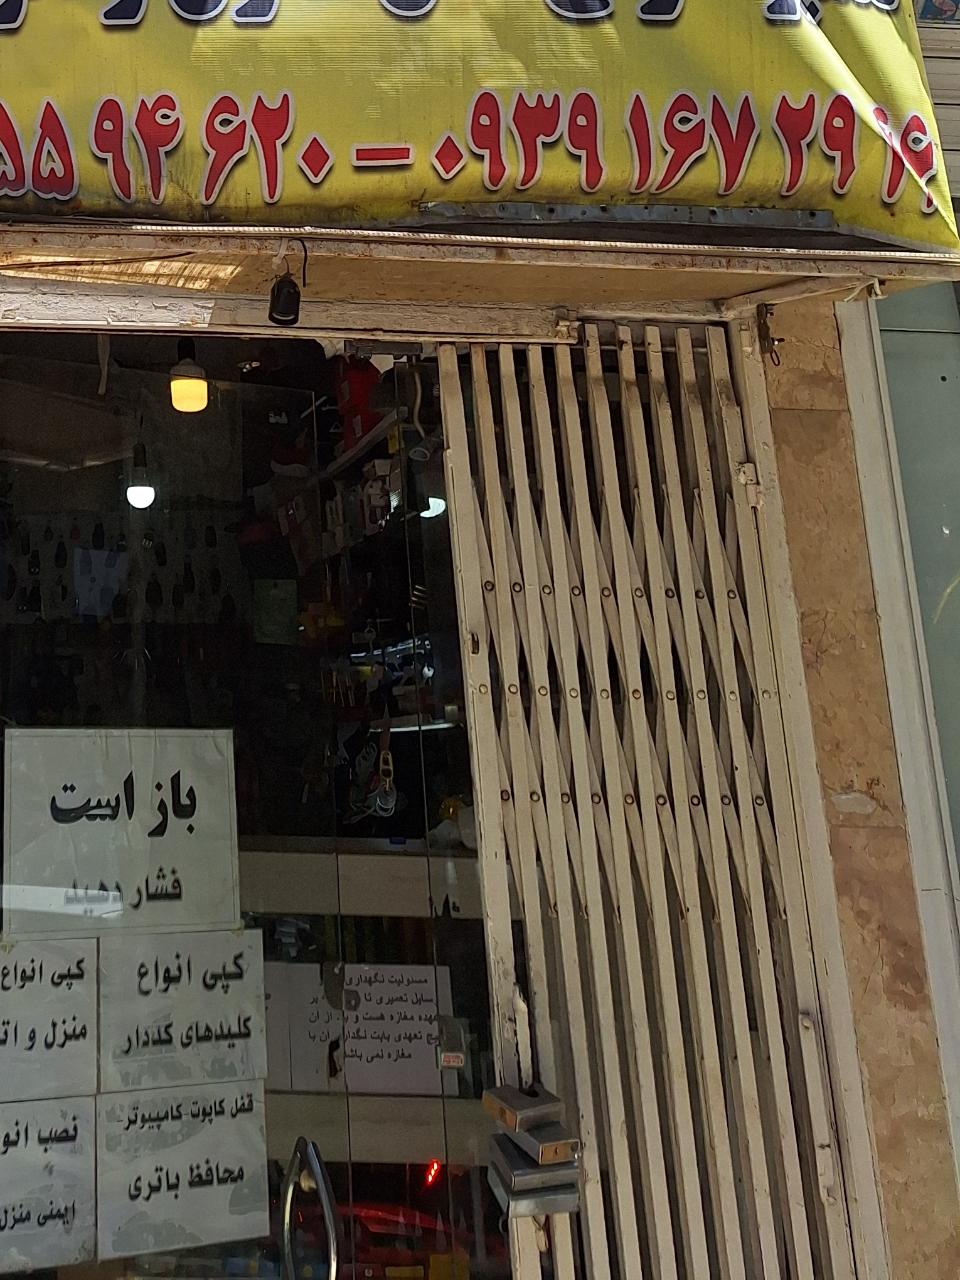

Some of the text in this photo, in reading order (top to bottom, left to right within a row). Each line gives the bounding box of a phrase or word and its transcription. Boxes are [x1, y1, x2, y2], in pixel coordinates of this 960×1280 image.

[50, 769, 197, 838] باز است
[130, 867, 182, 910] فشار
[0, 957, 43, 991] انواع
[51, 957, 85, 990] کپی
[137, 951, 245, 996] کپی انواع
[25, 1026, 36, 1051] و
[44, 1015, 88, 1048] منزل
[122, 1015, 252, 1054] کلیدهای کددار
[230, 1093, 254, 1118] قفل
[38, 1115, 79, 1153] نصب
[128, 1158, 245, 1202] محافظ باتری
[0, 1204, 31, 1232] منزل
